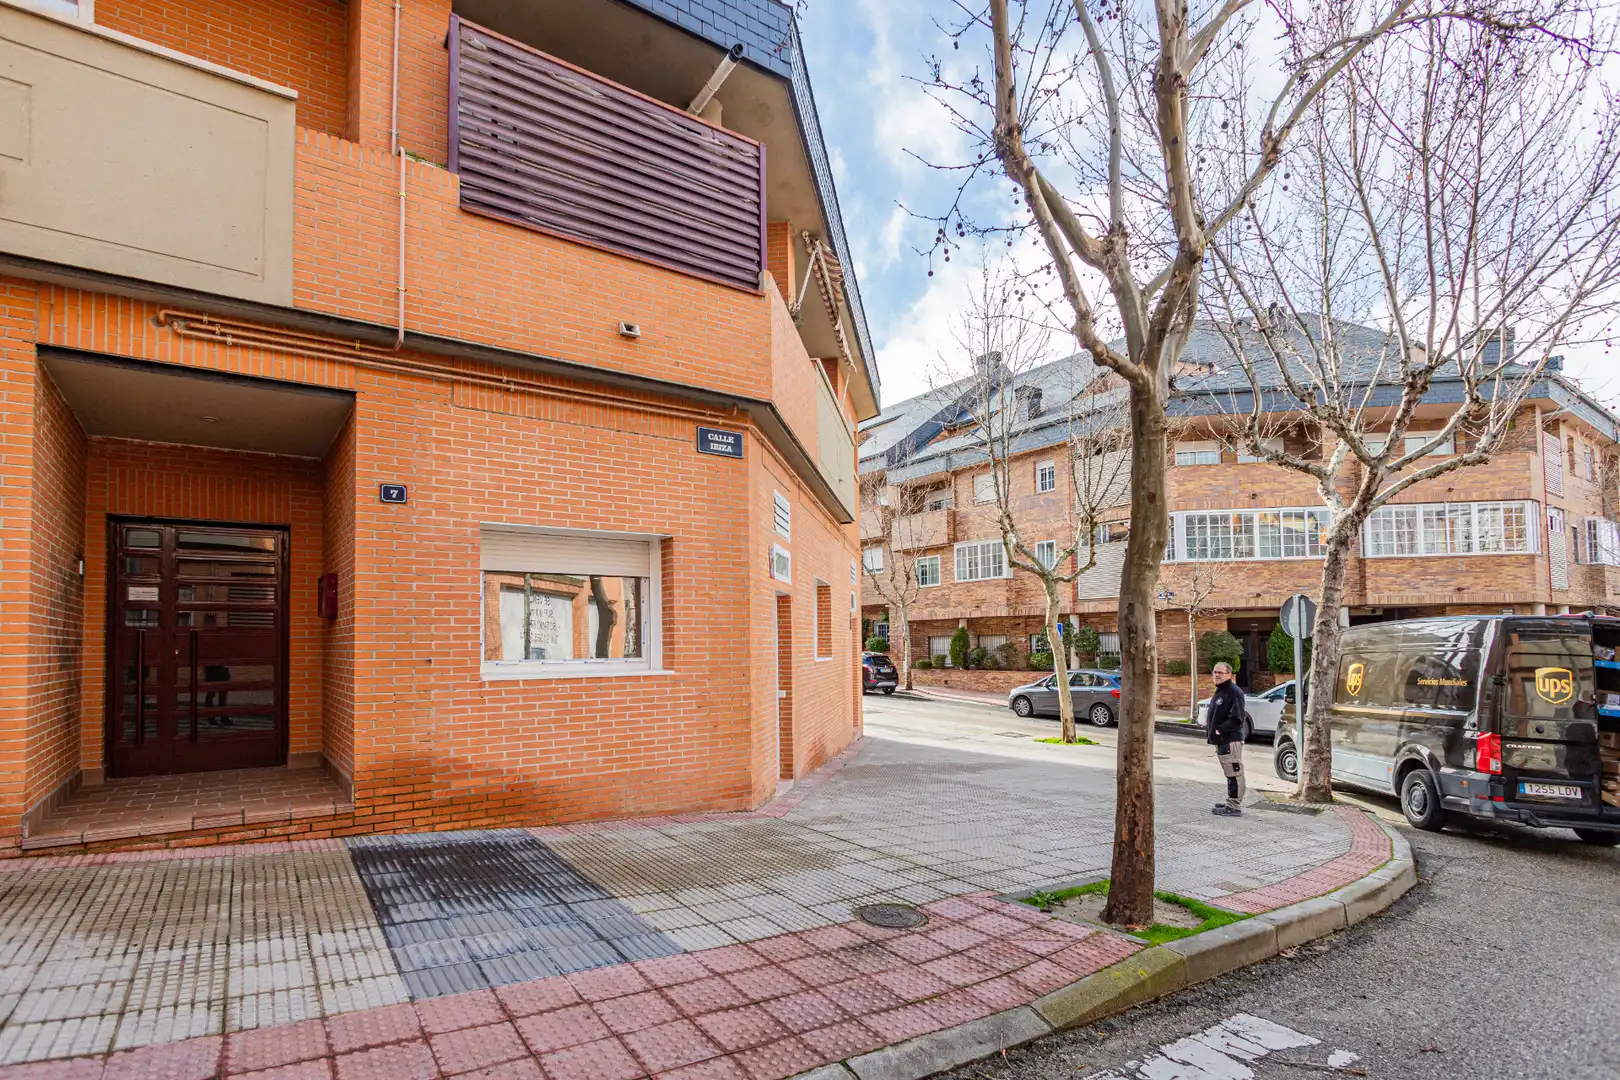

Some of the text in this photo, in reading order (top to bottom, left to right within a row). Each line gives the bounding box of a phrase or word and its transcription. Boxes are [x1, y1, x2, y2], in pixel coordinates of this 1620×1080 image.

[708, 433, 735, 444] CALLE
[710, 443, 733, 453] IBIZA
[390, 489, 399, 498] 7
[1417, 677, 1467, 687] Servicios Mundiales
[1539, 677, 1570, 698] ups
[1528, 784, 1555, 795] 1255
[1558, 786, 1579, 797] LDV
